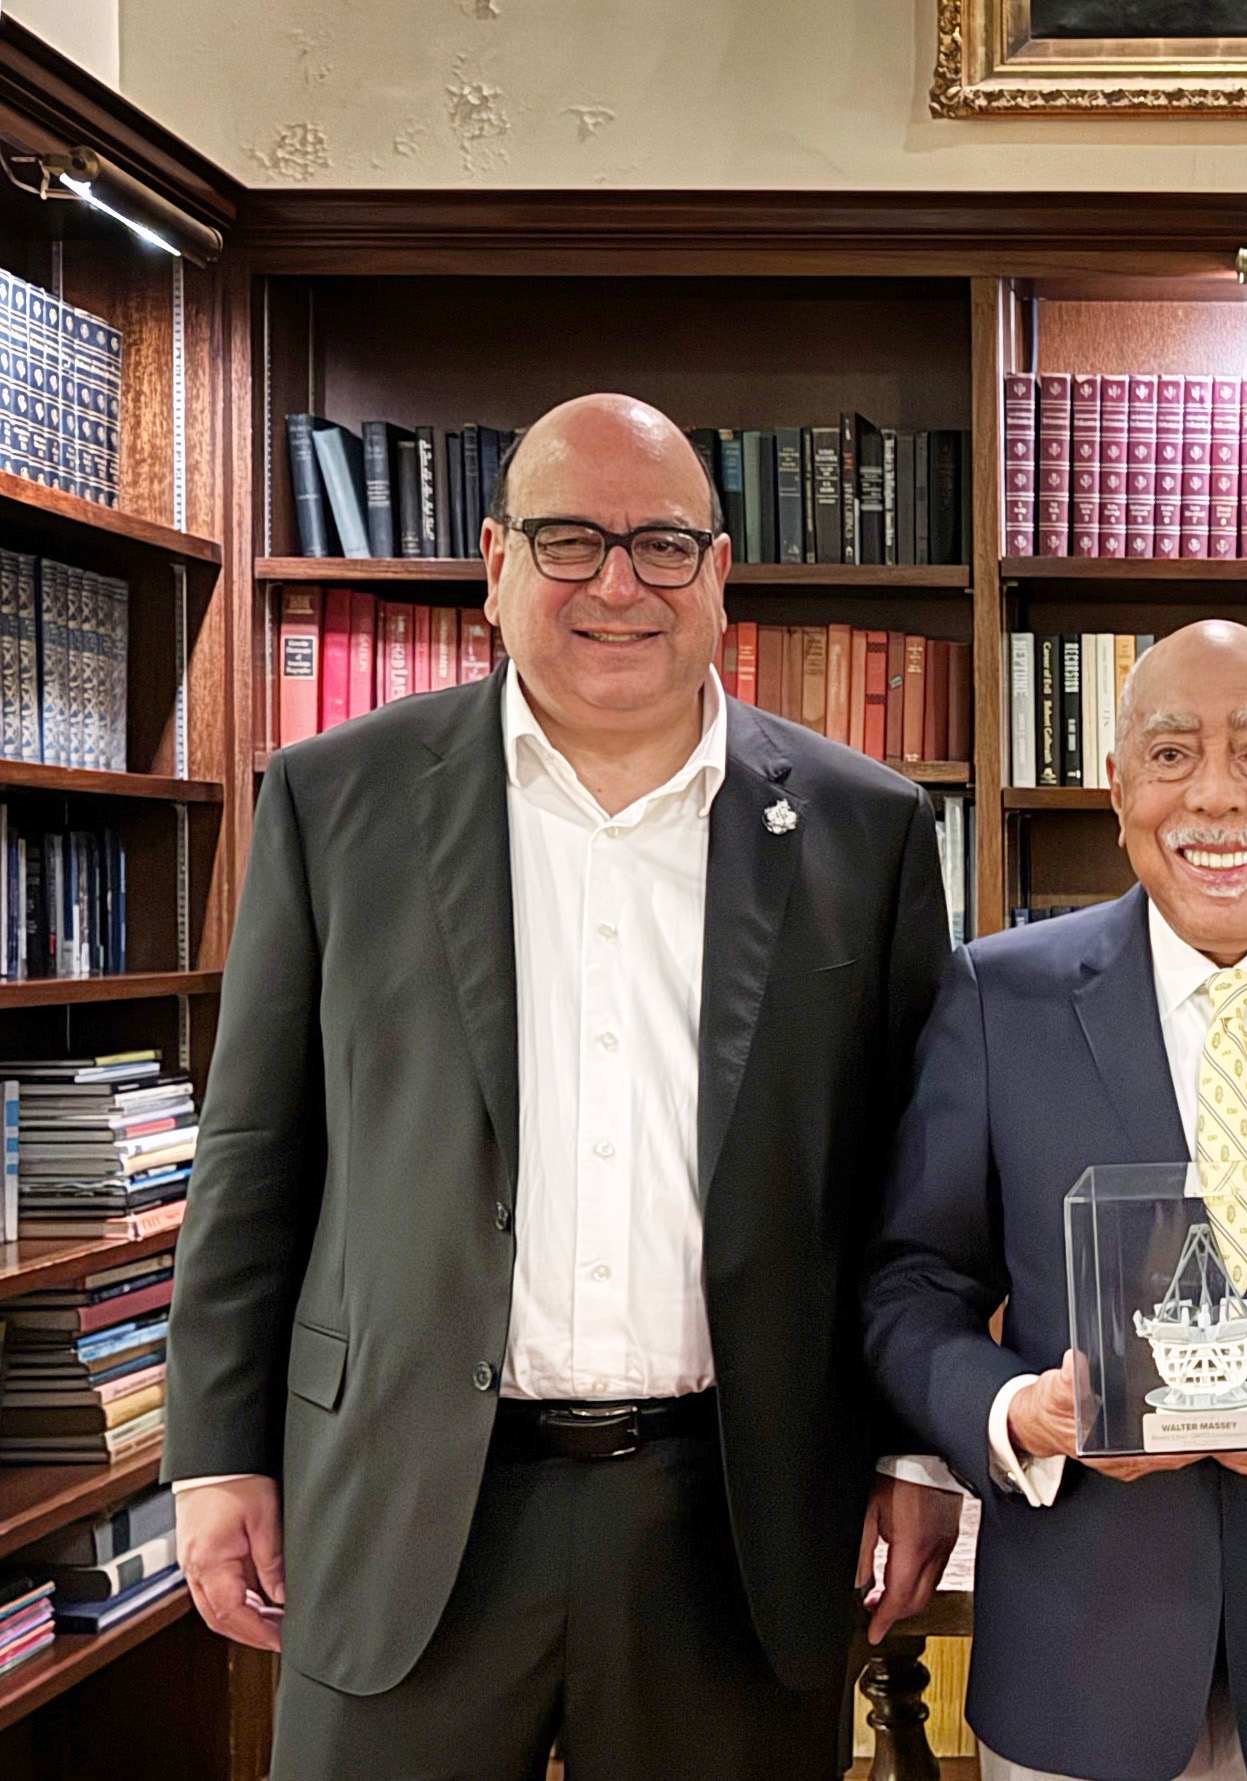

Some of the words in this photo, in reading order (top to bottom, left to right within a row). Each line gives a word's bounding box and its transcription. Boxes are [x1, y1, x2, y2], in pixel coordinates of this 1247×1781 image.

[1064, 643, 1079, 693] RECURSION
[1162, 1423, 1197, 1433] WALTER
[1200, 1421, 1237, 1431] MASSEY
